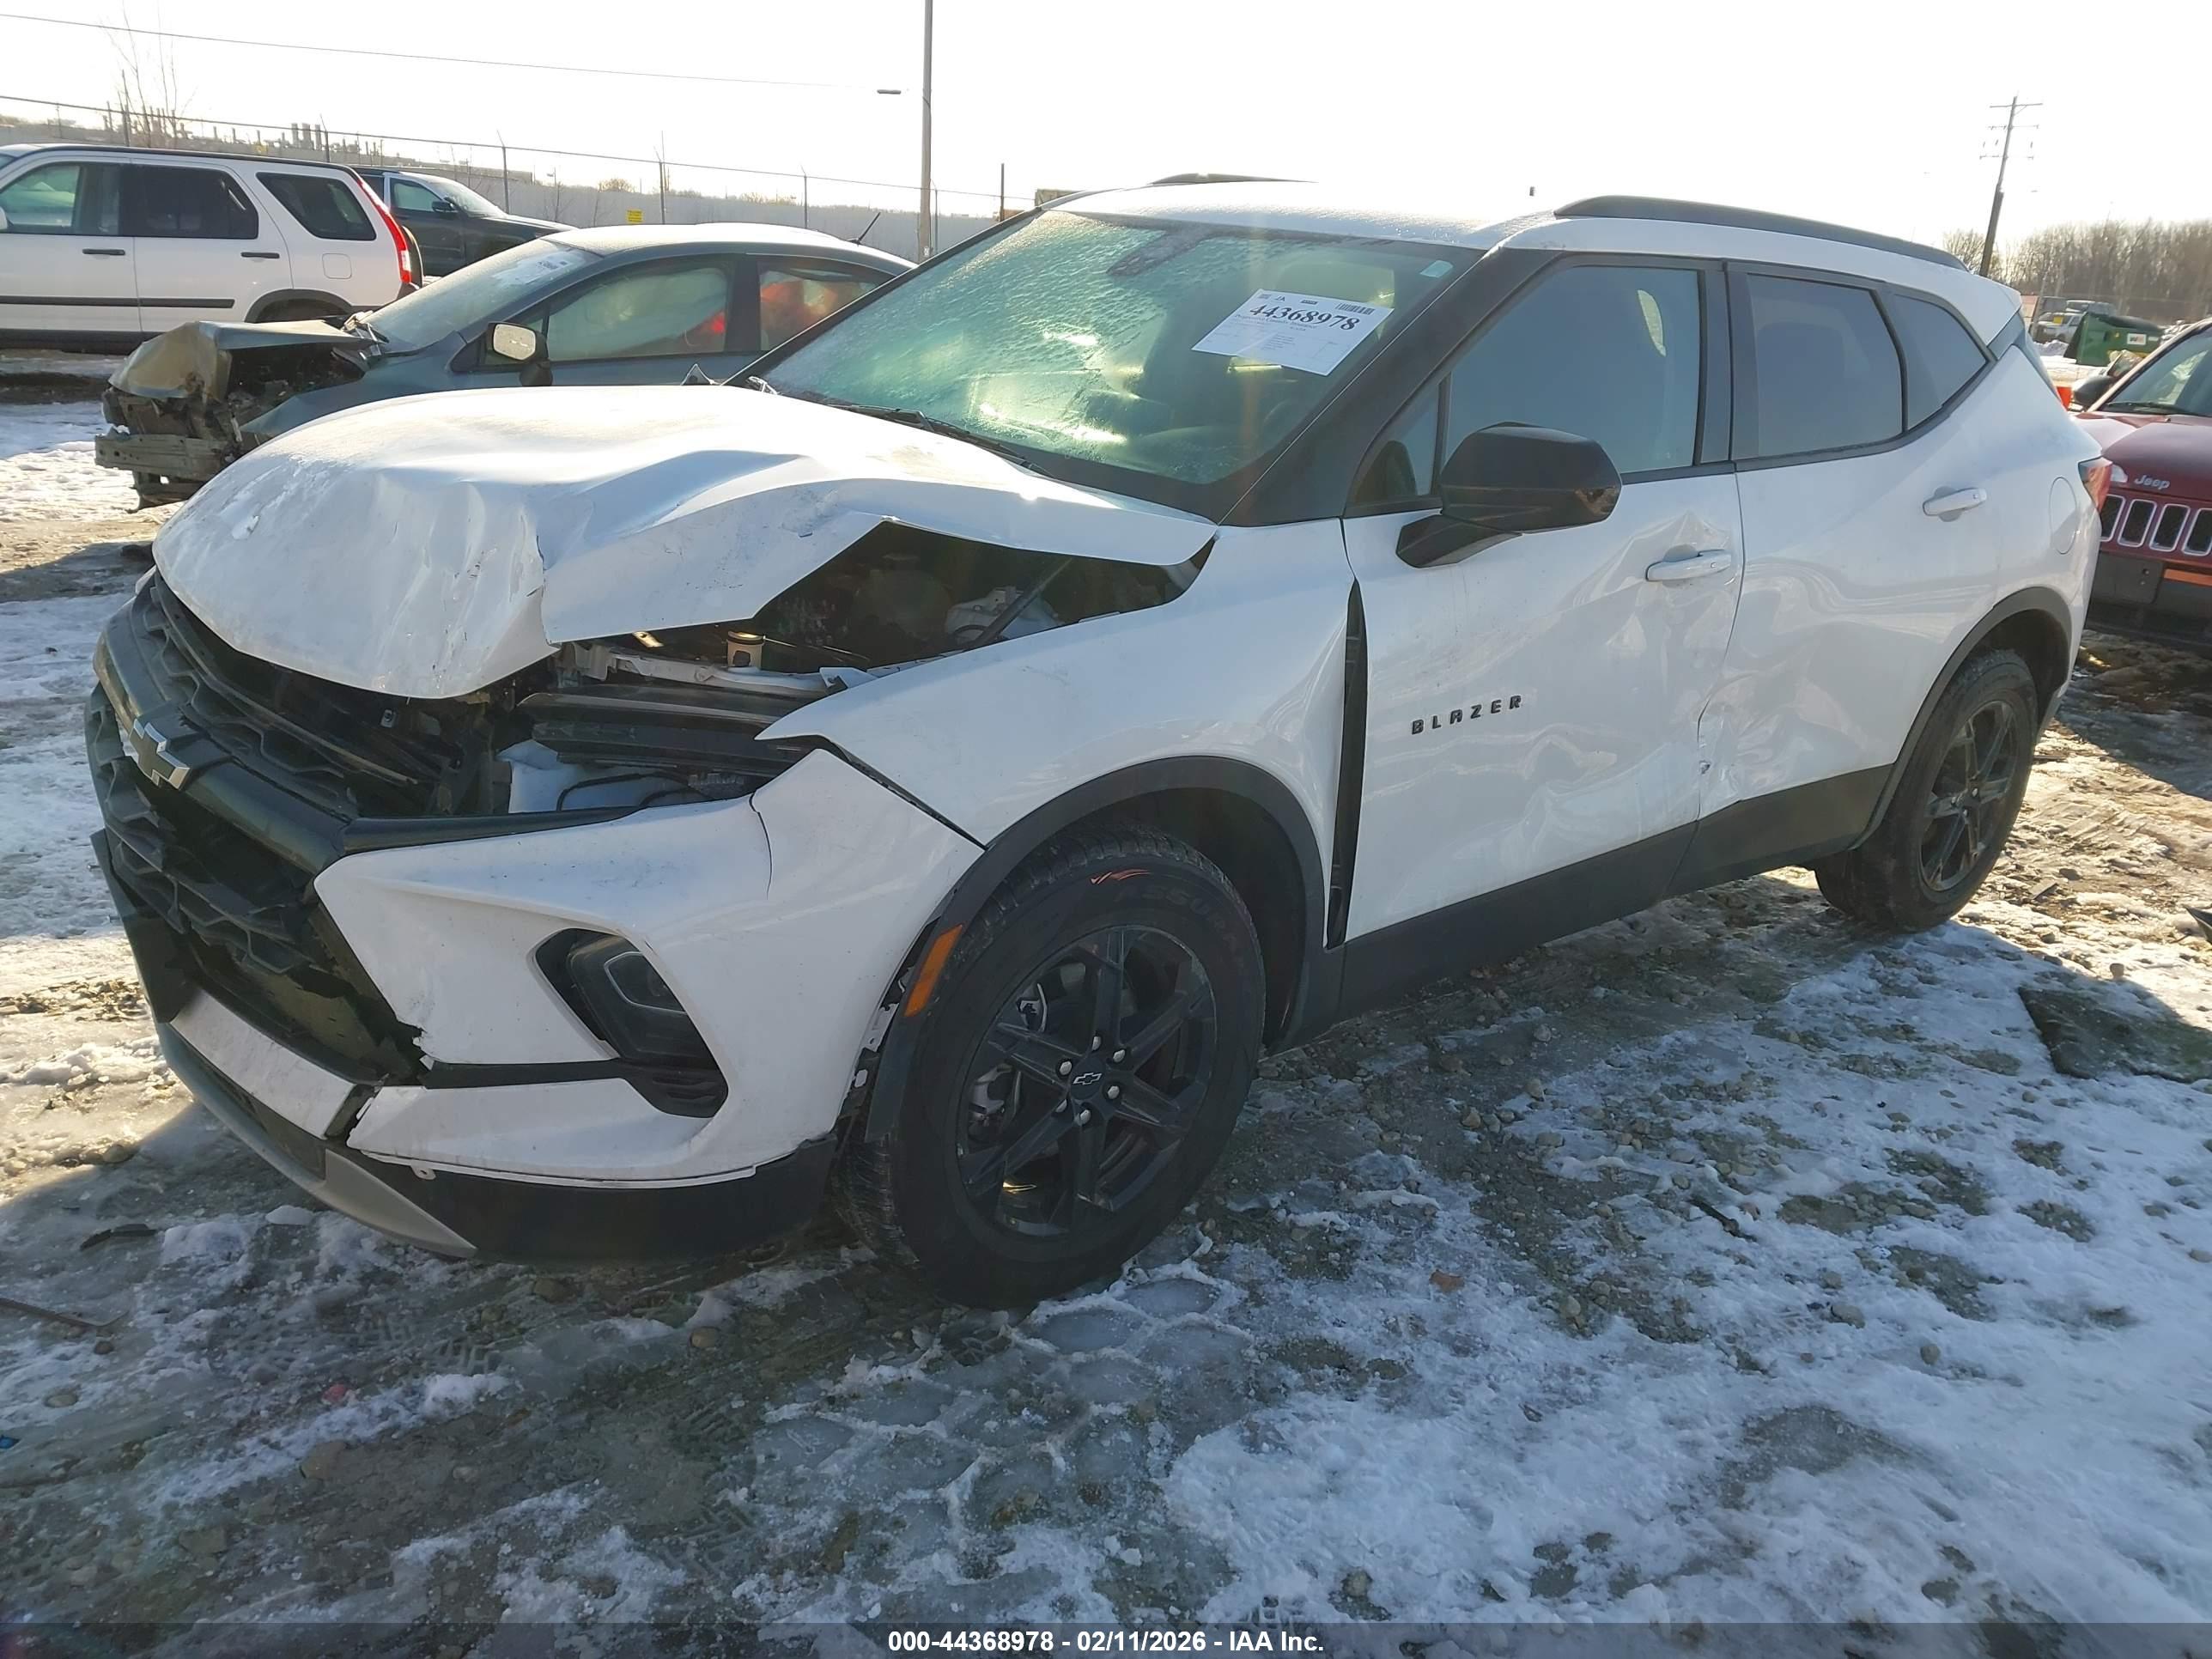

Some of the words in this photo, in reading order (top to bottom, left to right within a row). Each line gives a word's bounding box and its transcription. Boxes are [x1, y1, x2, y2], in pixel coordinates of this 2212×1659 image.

[1249, 304, 1360, 331] 44368978
[2134, 475, 2170, 489] Jeep
[1411, 695, 1522, 735] BLAZER
